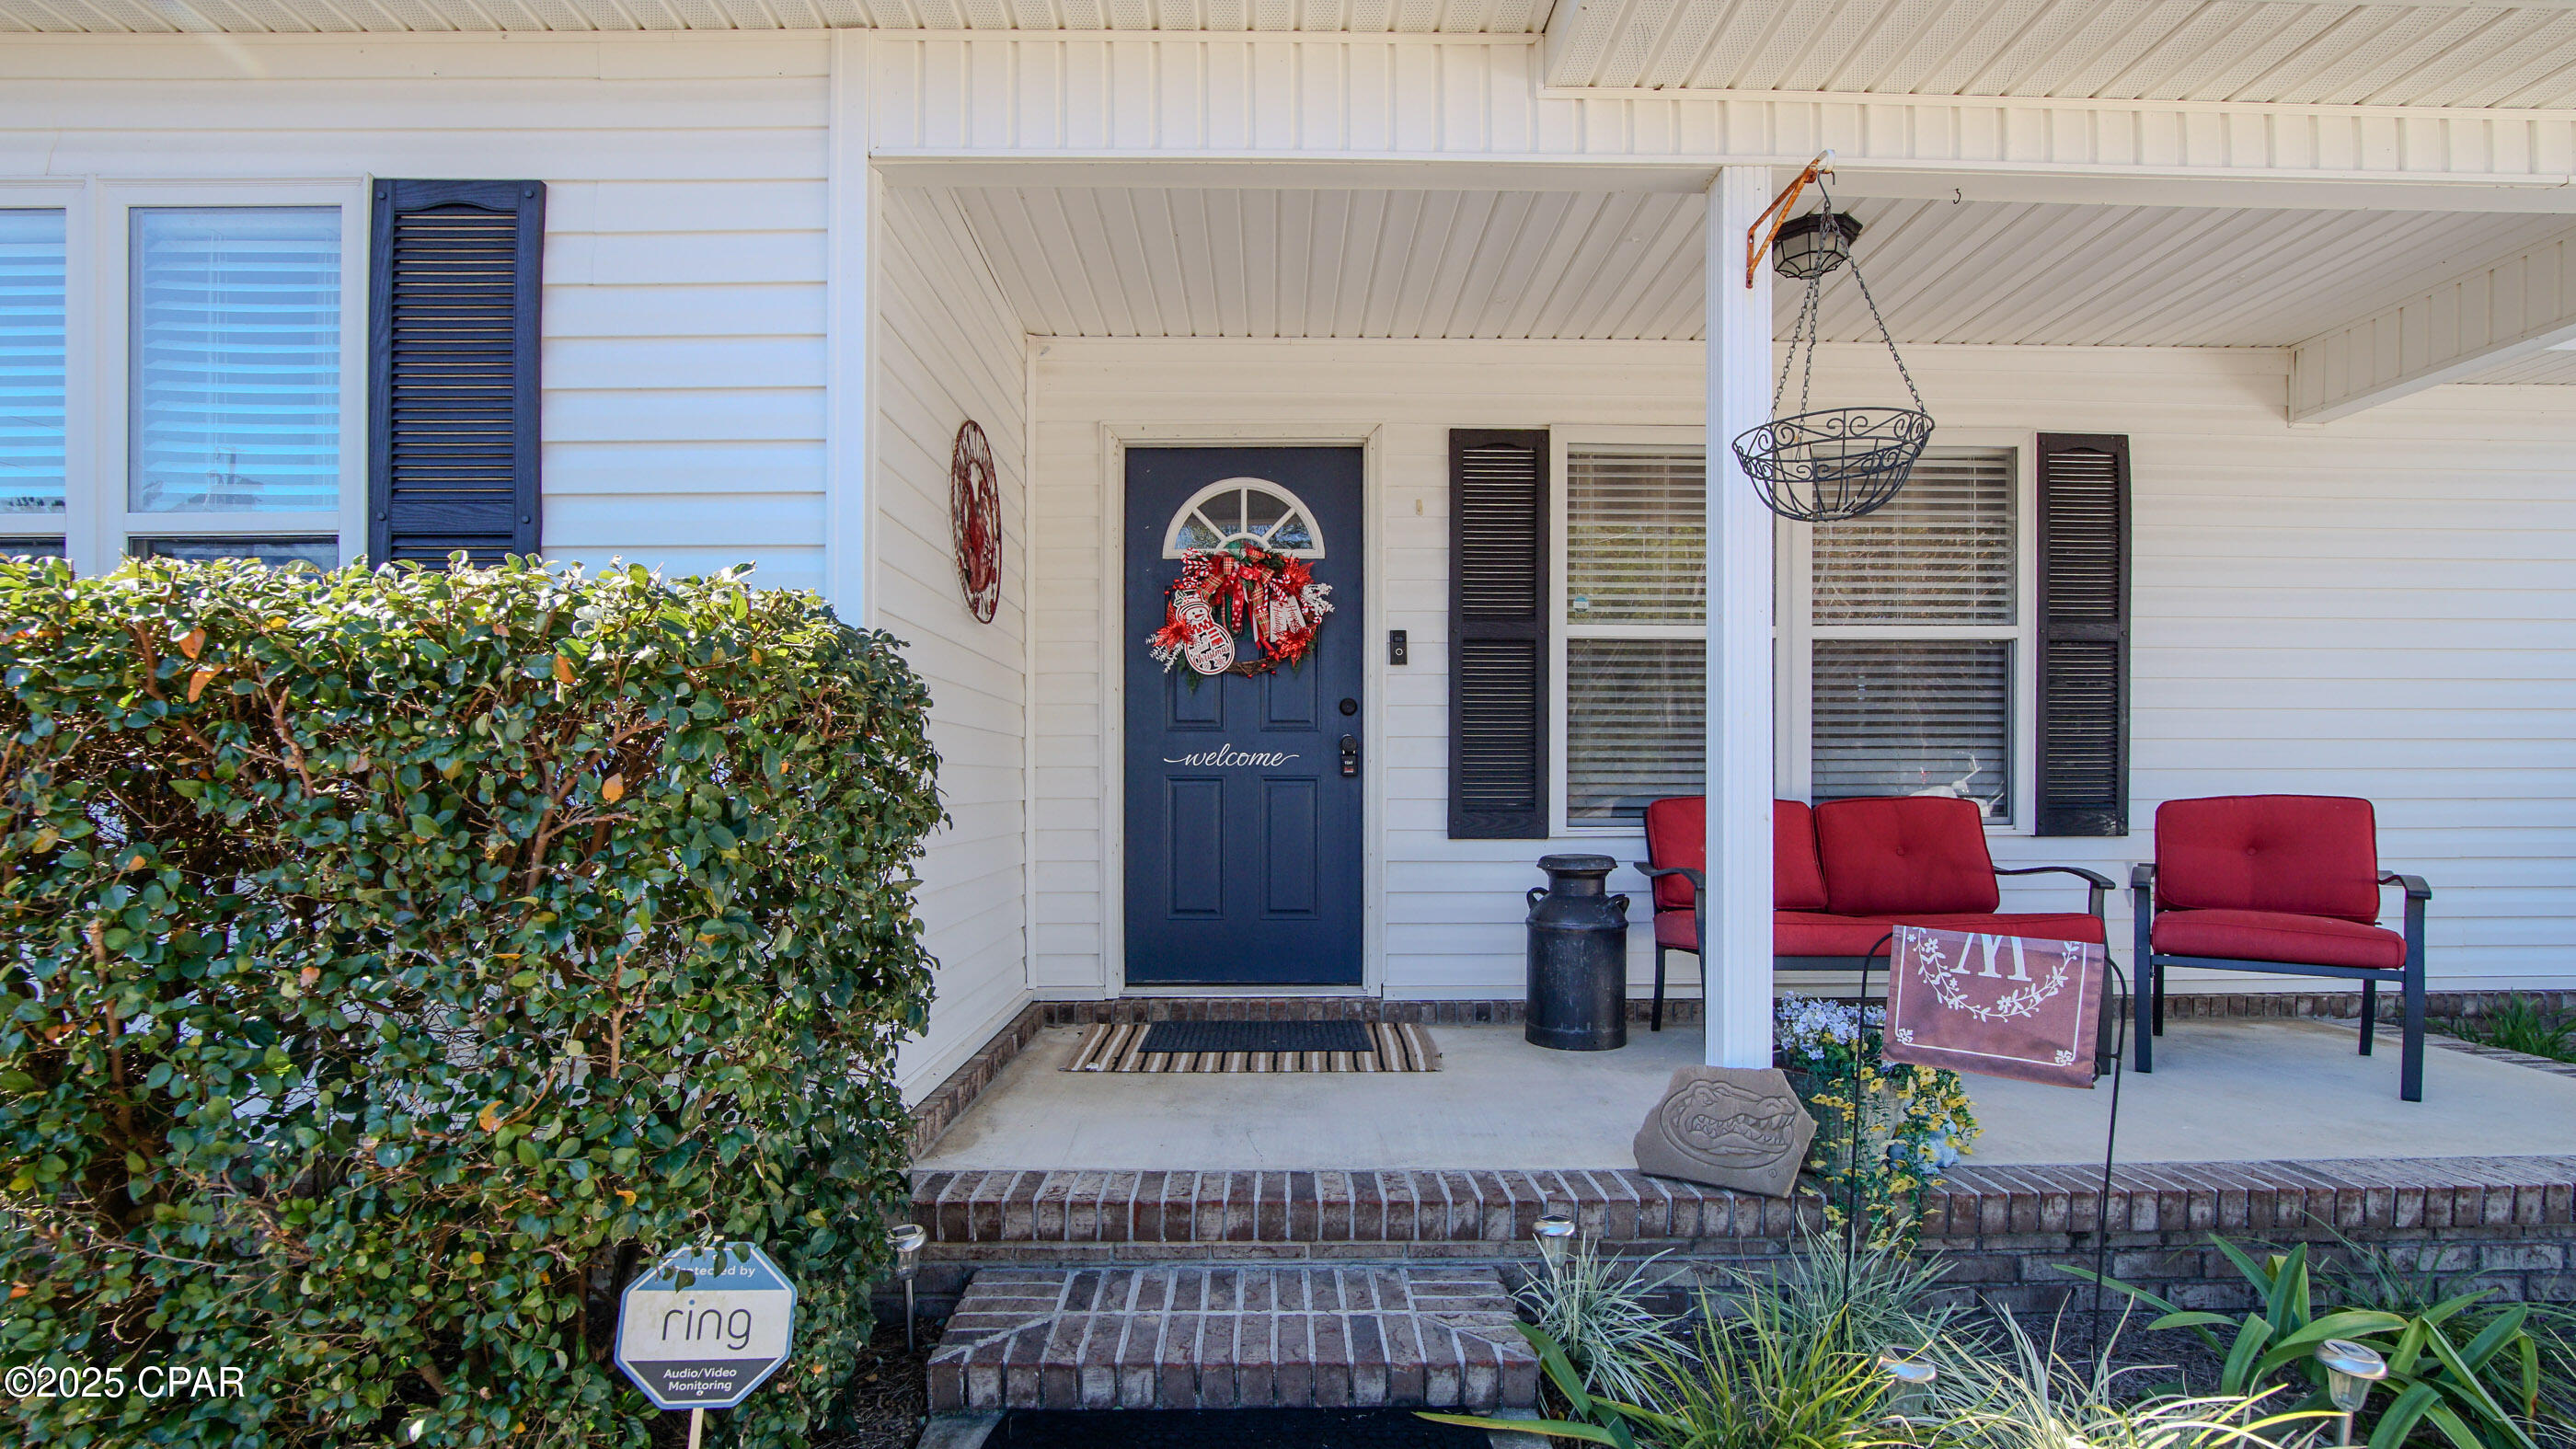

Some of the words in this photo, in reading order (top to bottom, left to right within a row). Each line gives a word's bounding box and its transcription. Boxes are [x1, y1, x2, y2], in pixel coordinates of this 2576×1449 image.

[1193, 646, 1230, 665] Christmas
[1163, 742, 1300, 766] welcome
[675, 1265, 737, 1276] Pteced
[740, 1266, 756, 1278] by
[661, 1298, 752, 1351] ring
[662, 1367, 738, 1379] Audio/Video
[668, 1381, 732, 1392] Monitoring
